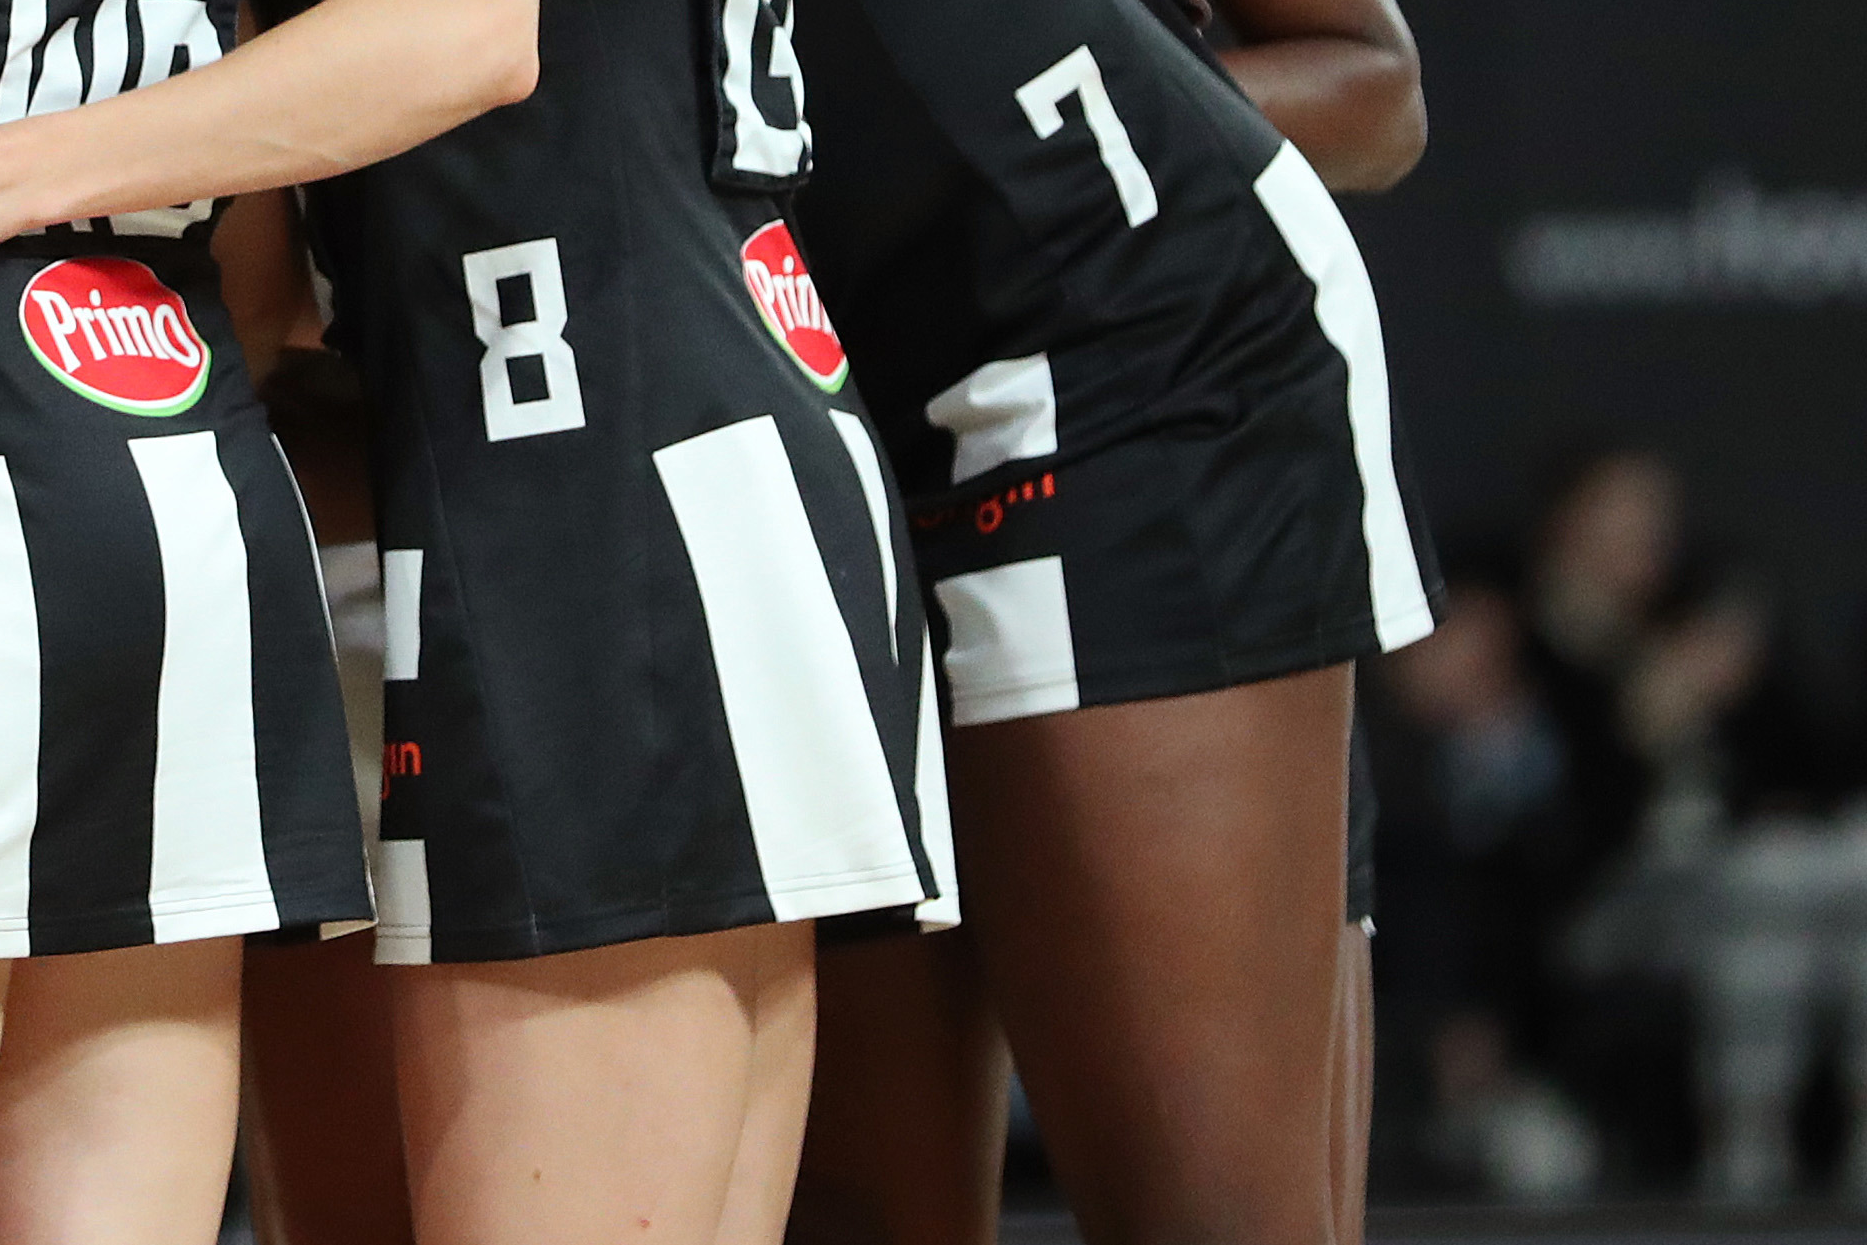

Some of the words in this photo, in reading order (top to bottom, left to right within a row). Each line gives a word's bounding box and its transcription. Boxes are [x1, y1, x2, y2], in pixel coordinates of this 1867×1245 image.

[1014, 43, 1159, 228] 7
[31, 289, 201, 374] Primo
[462, 237, 586, 442] 8
[744, 255, 842, 347] Prim
